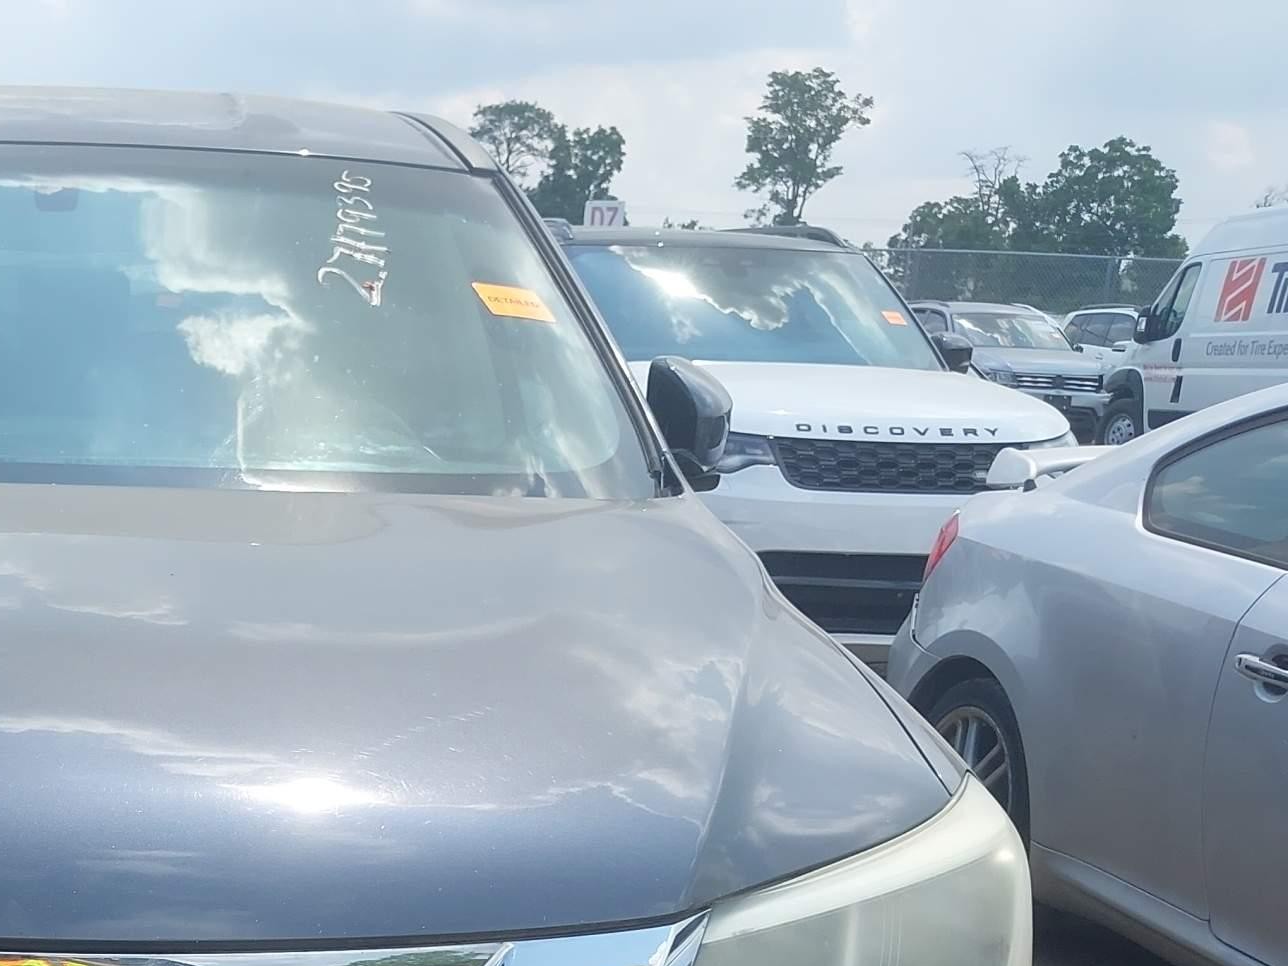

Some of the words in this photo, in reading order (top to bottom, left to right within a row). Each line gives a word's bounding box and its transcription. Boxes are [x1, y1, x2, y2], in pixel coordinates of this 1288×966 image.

[1206, 340, 1237, 356] Created
[1238, 340, 1250, 357] for
[795, 423, 999, 437] DISCOVERY
